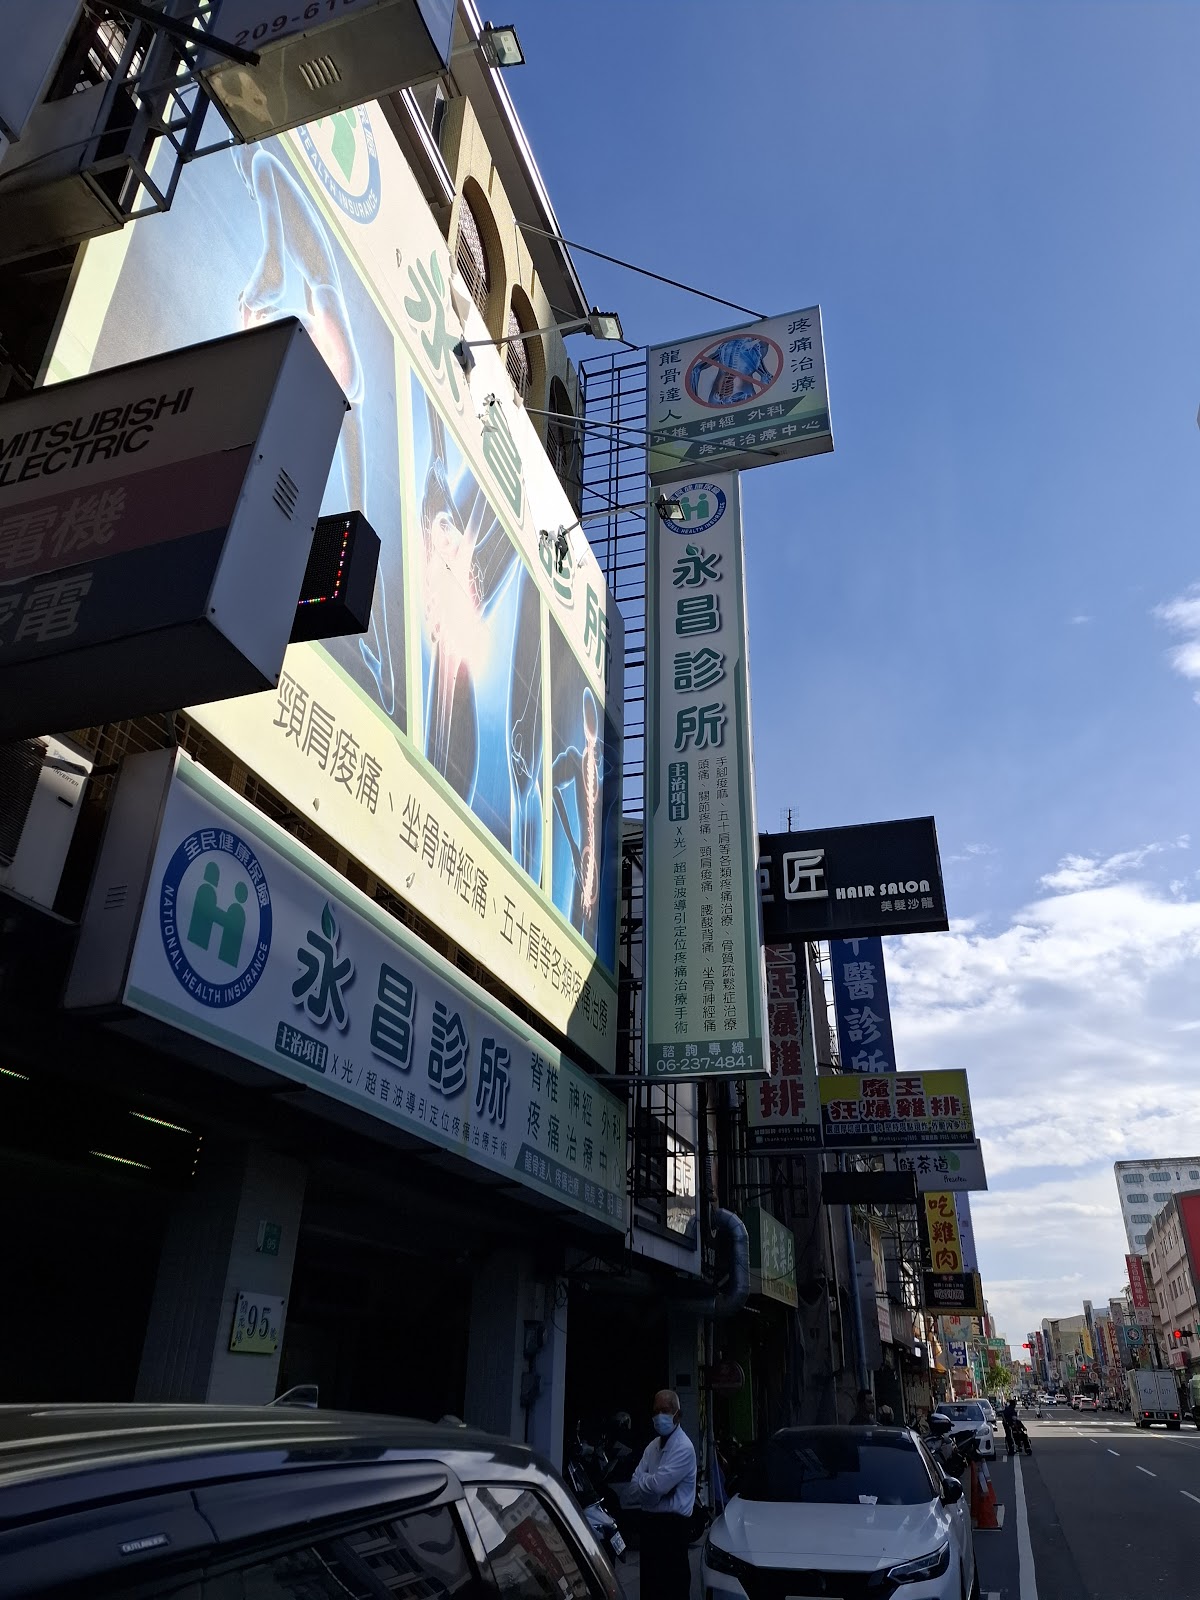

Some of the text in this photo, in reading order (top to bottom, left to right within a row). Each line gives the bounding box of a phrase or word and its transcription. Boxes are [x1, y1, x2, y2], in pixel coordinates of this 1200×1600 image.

[235, 0, 355, 46] 209-61
[787, 317, 816, 393] 疼痛治療
[658, 348, 683, 424] 龍骨達人
[700, 414, 736, 433] 神經
[747, 403, 785, 421] 外科
[0, 424, 154, 488] LECTRIC
[672, 542, 726, 751] 永昌診所
[670, 763, 687, 820] 主治項目
[183, 830, 269, 908] 全民健康保險
[835, 879, 931, 900] HAIR SALON
[880, 896, 935, 912] 美髮沙龍
[163, 884, 268, 1003] NATIONAL HEALTH INSURANCE
[291, 901, 511, 1125] 永昌診所
[277, 1025, 328, 1069] 主治項目
[656, 1054, 753, 1072] 06-237-4841
[662, 1041, 745, 1058] 諮詢專線
[829, 1096, 962, 1121] 狂爆雞排
[862, 1077, 924, 1098] 魔王
[568, 1081, 593, 1127] 神經
[601, 1104, 622, 1149] 外科
[527, 1100, 622, 1189] 疼痛治療中心
[899, 1154, 949, 1174] 鮮茶道
[928, 1196, 959, 1270] 吃雞肉
[246, 1305, 271, 1339] 95
